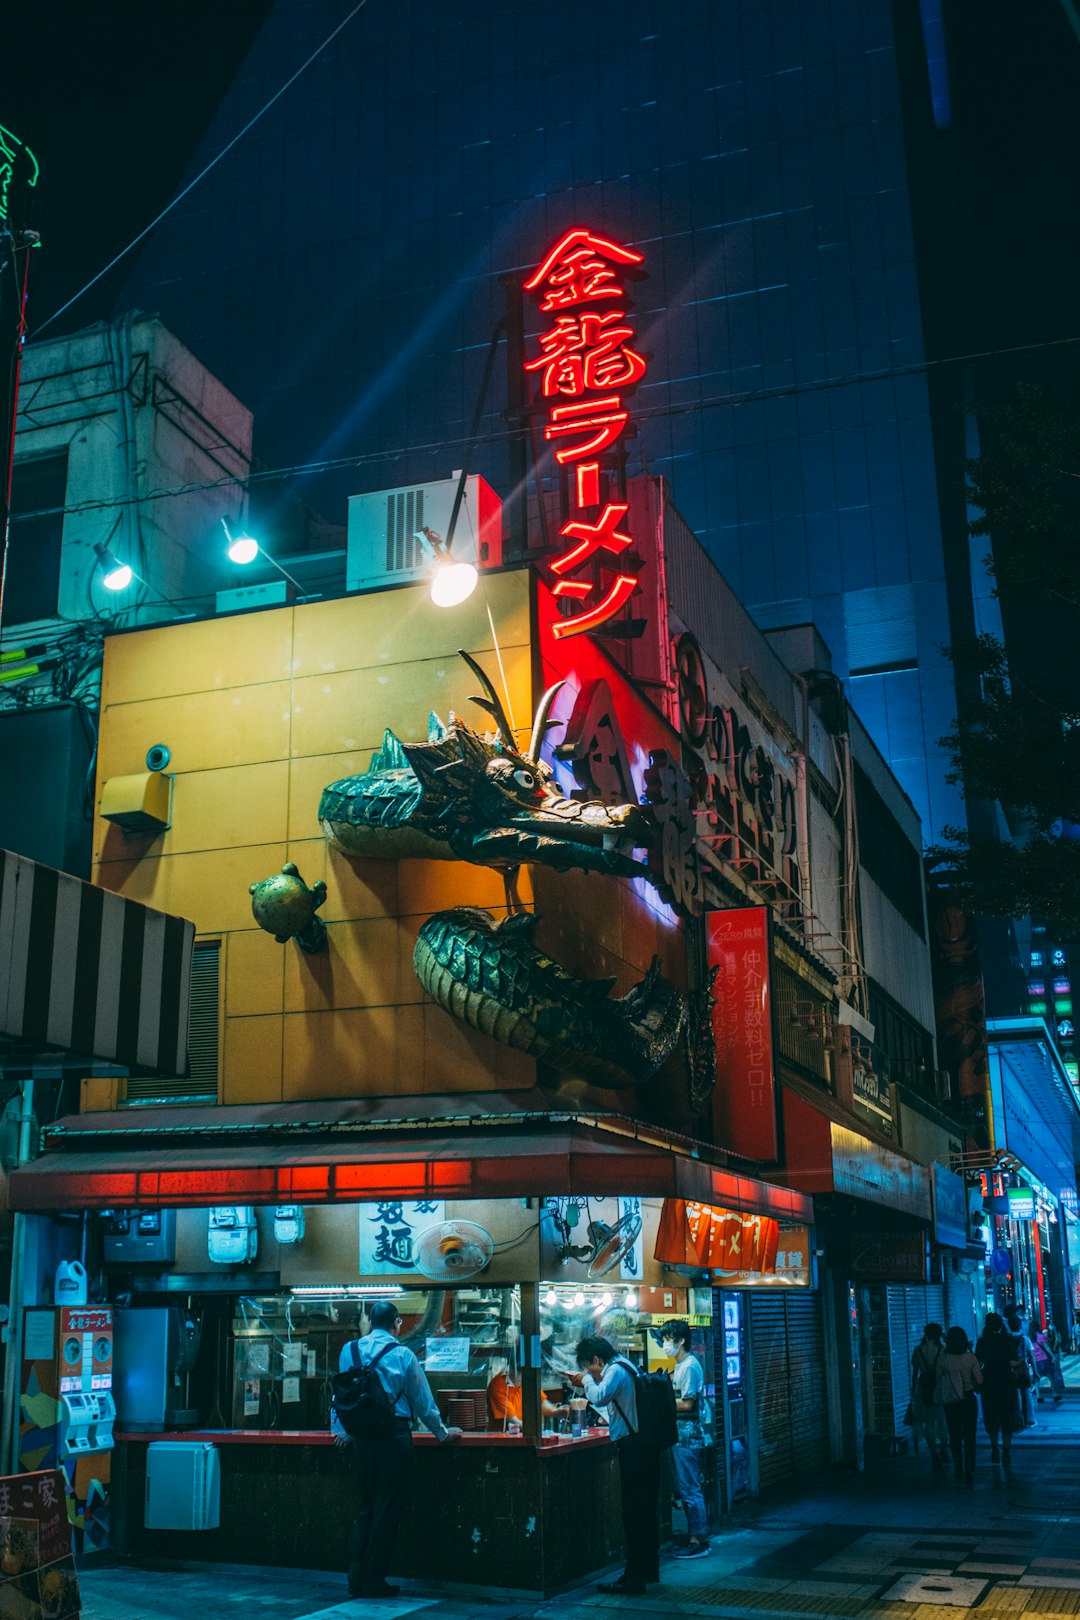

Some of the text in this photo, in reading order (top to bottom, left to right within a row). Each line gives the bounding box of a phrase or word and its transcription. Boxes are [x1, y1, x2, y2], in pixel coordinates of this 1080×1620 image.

[523, 229, 646, 641] 金龍ラーメン
